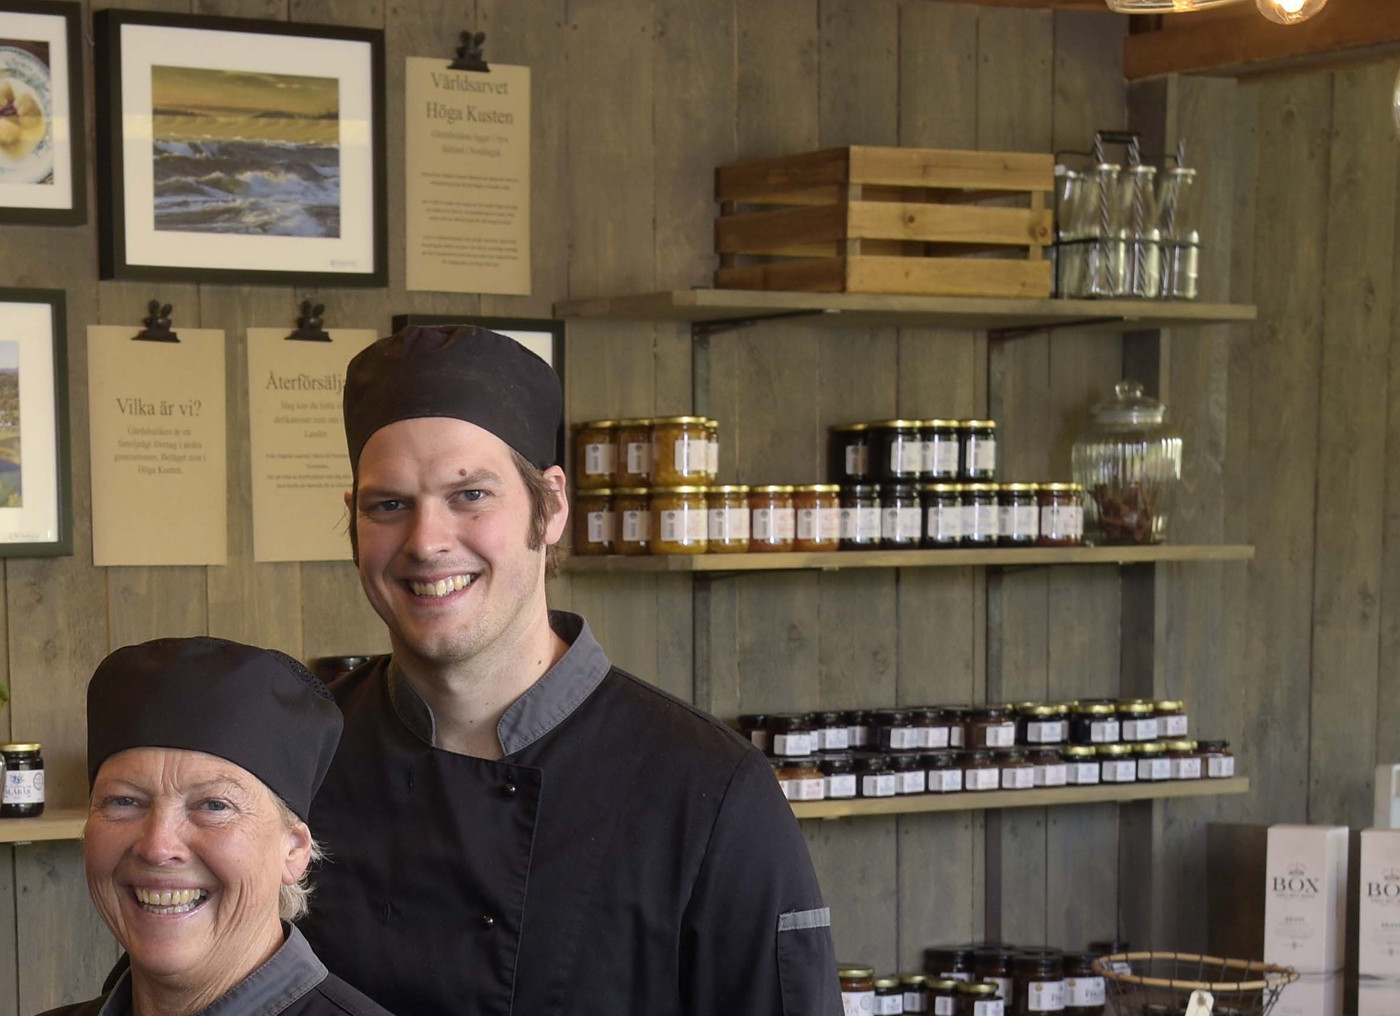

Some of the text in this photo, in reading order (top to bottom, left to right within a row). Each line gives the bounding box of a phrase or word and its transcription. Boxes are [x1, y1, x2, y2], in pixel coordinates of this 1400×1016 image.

[431, 71, 509, 95] Världsarvet
[426, 101, 514, 124] Höga Kusten
[116, 398, 203, 417] Vilka är vi?
[1273, 877, 1319, 894] BOX
